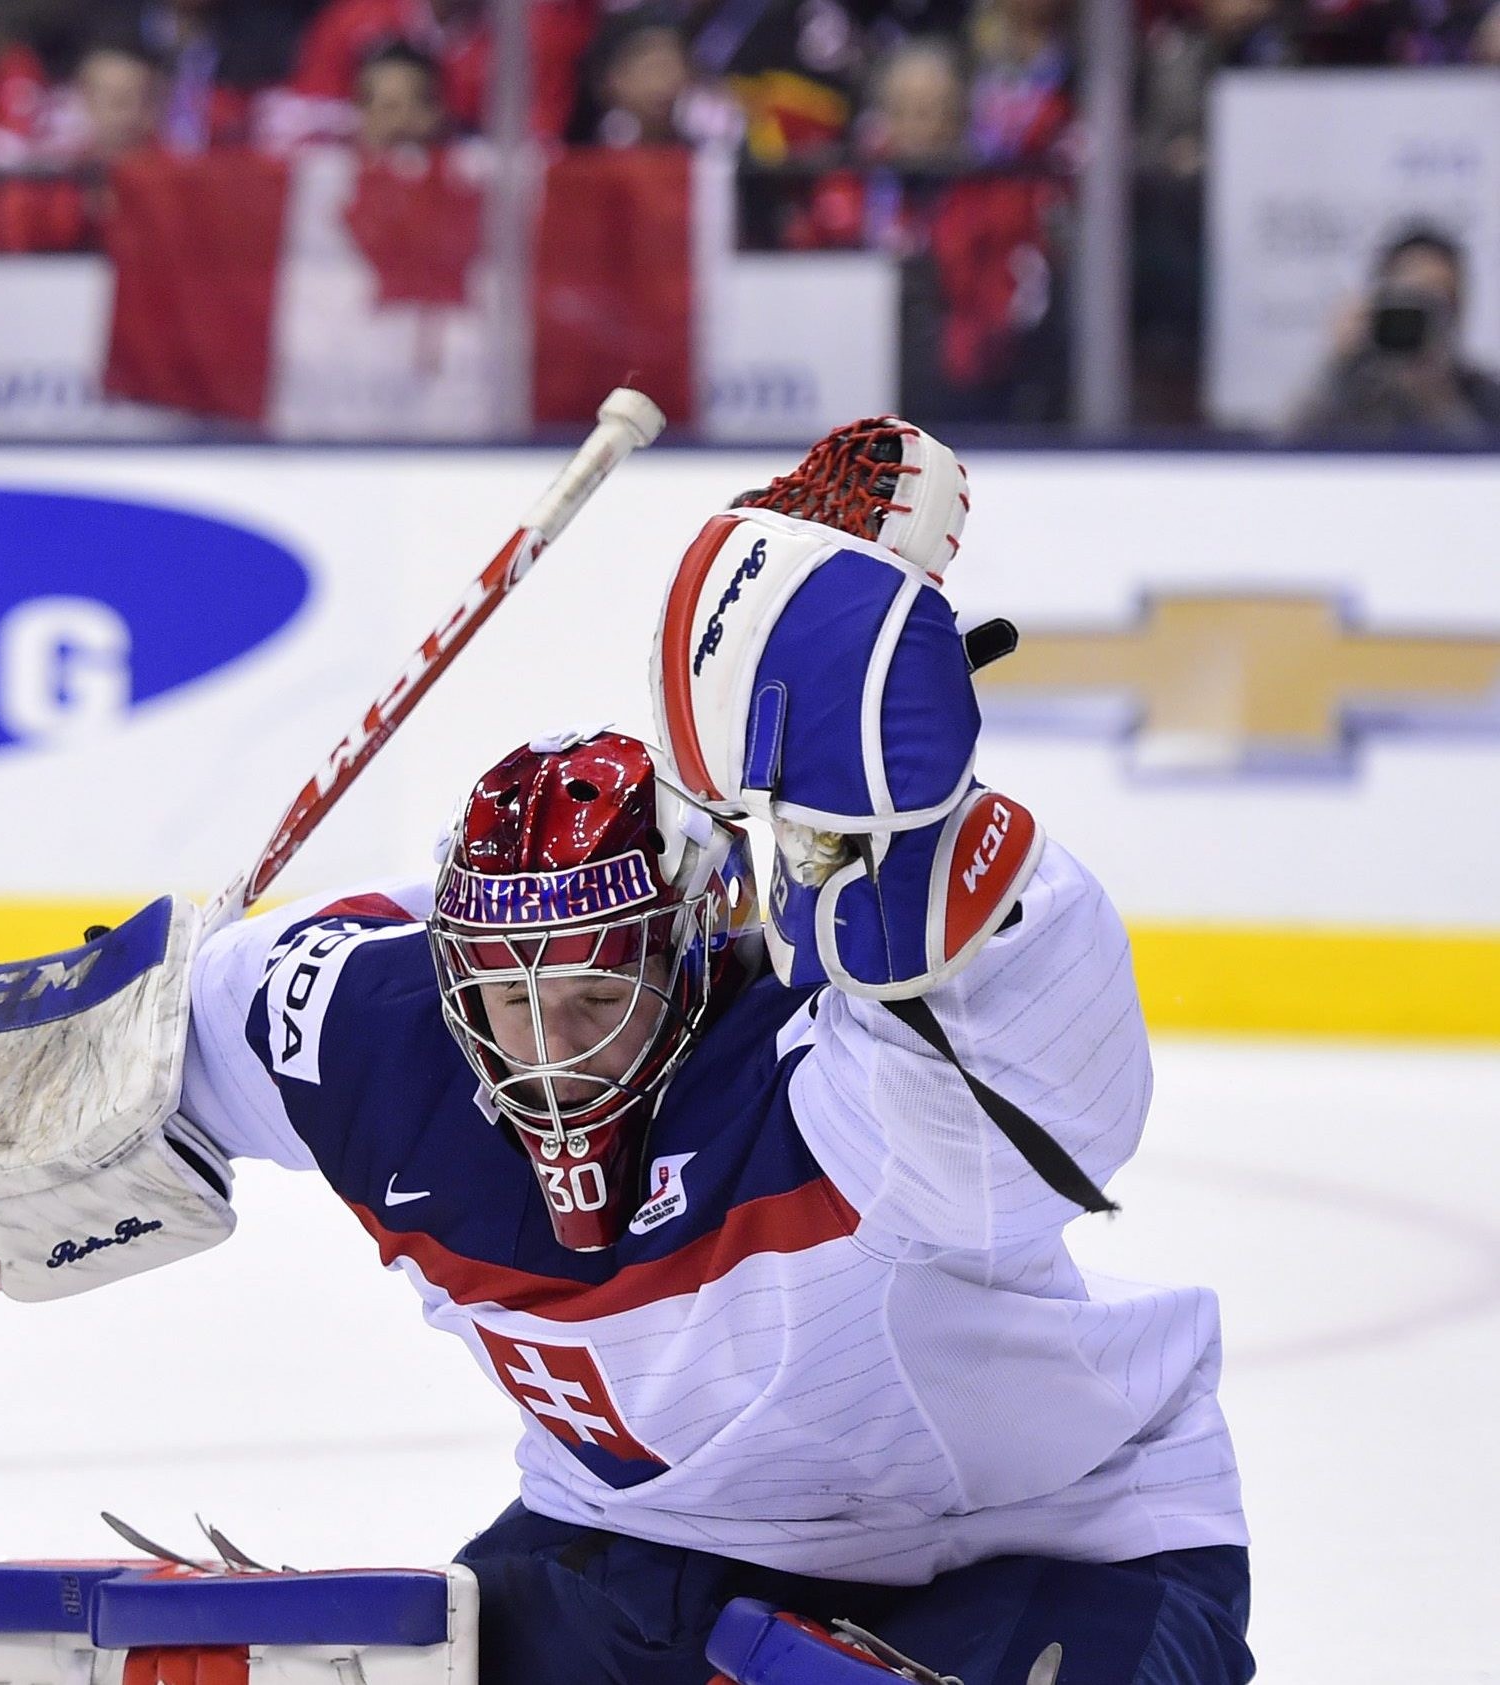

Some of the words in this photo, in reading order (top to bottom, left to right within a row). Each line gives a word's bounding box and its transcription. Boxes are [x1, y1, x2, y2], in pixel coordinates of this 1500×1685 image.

[963, 801, 1012, 894] CCM
[439, 853, 653, 925] SLOVENSKO
[537, 1161, 607, 1214] 30
